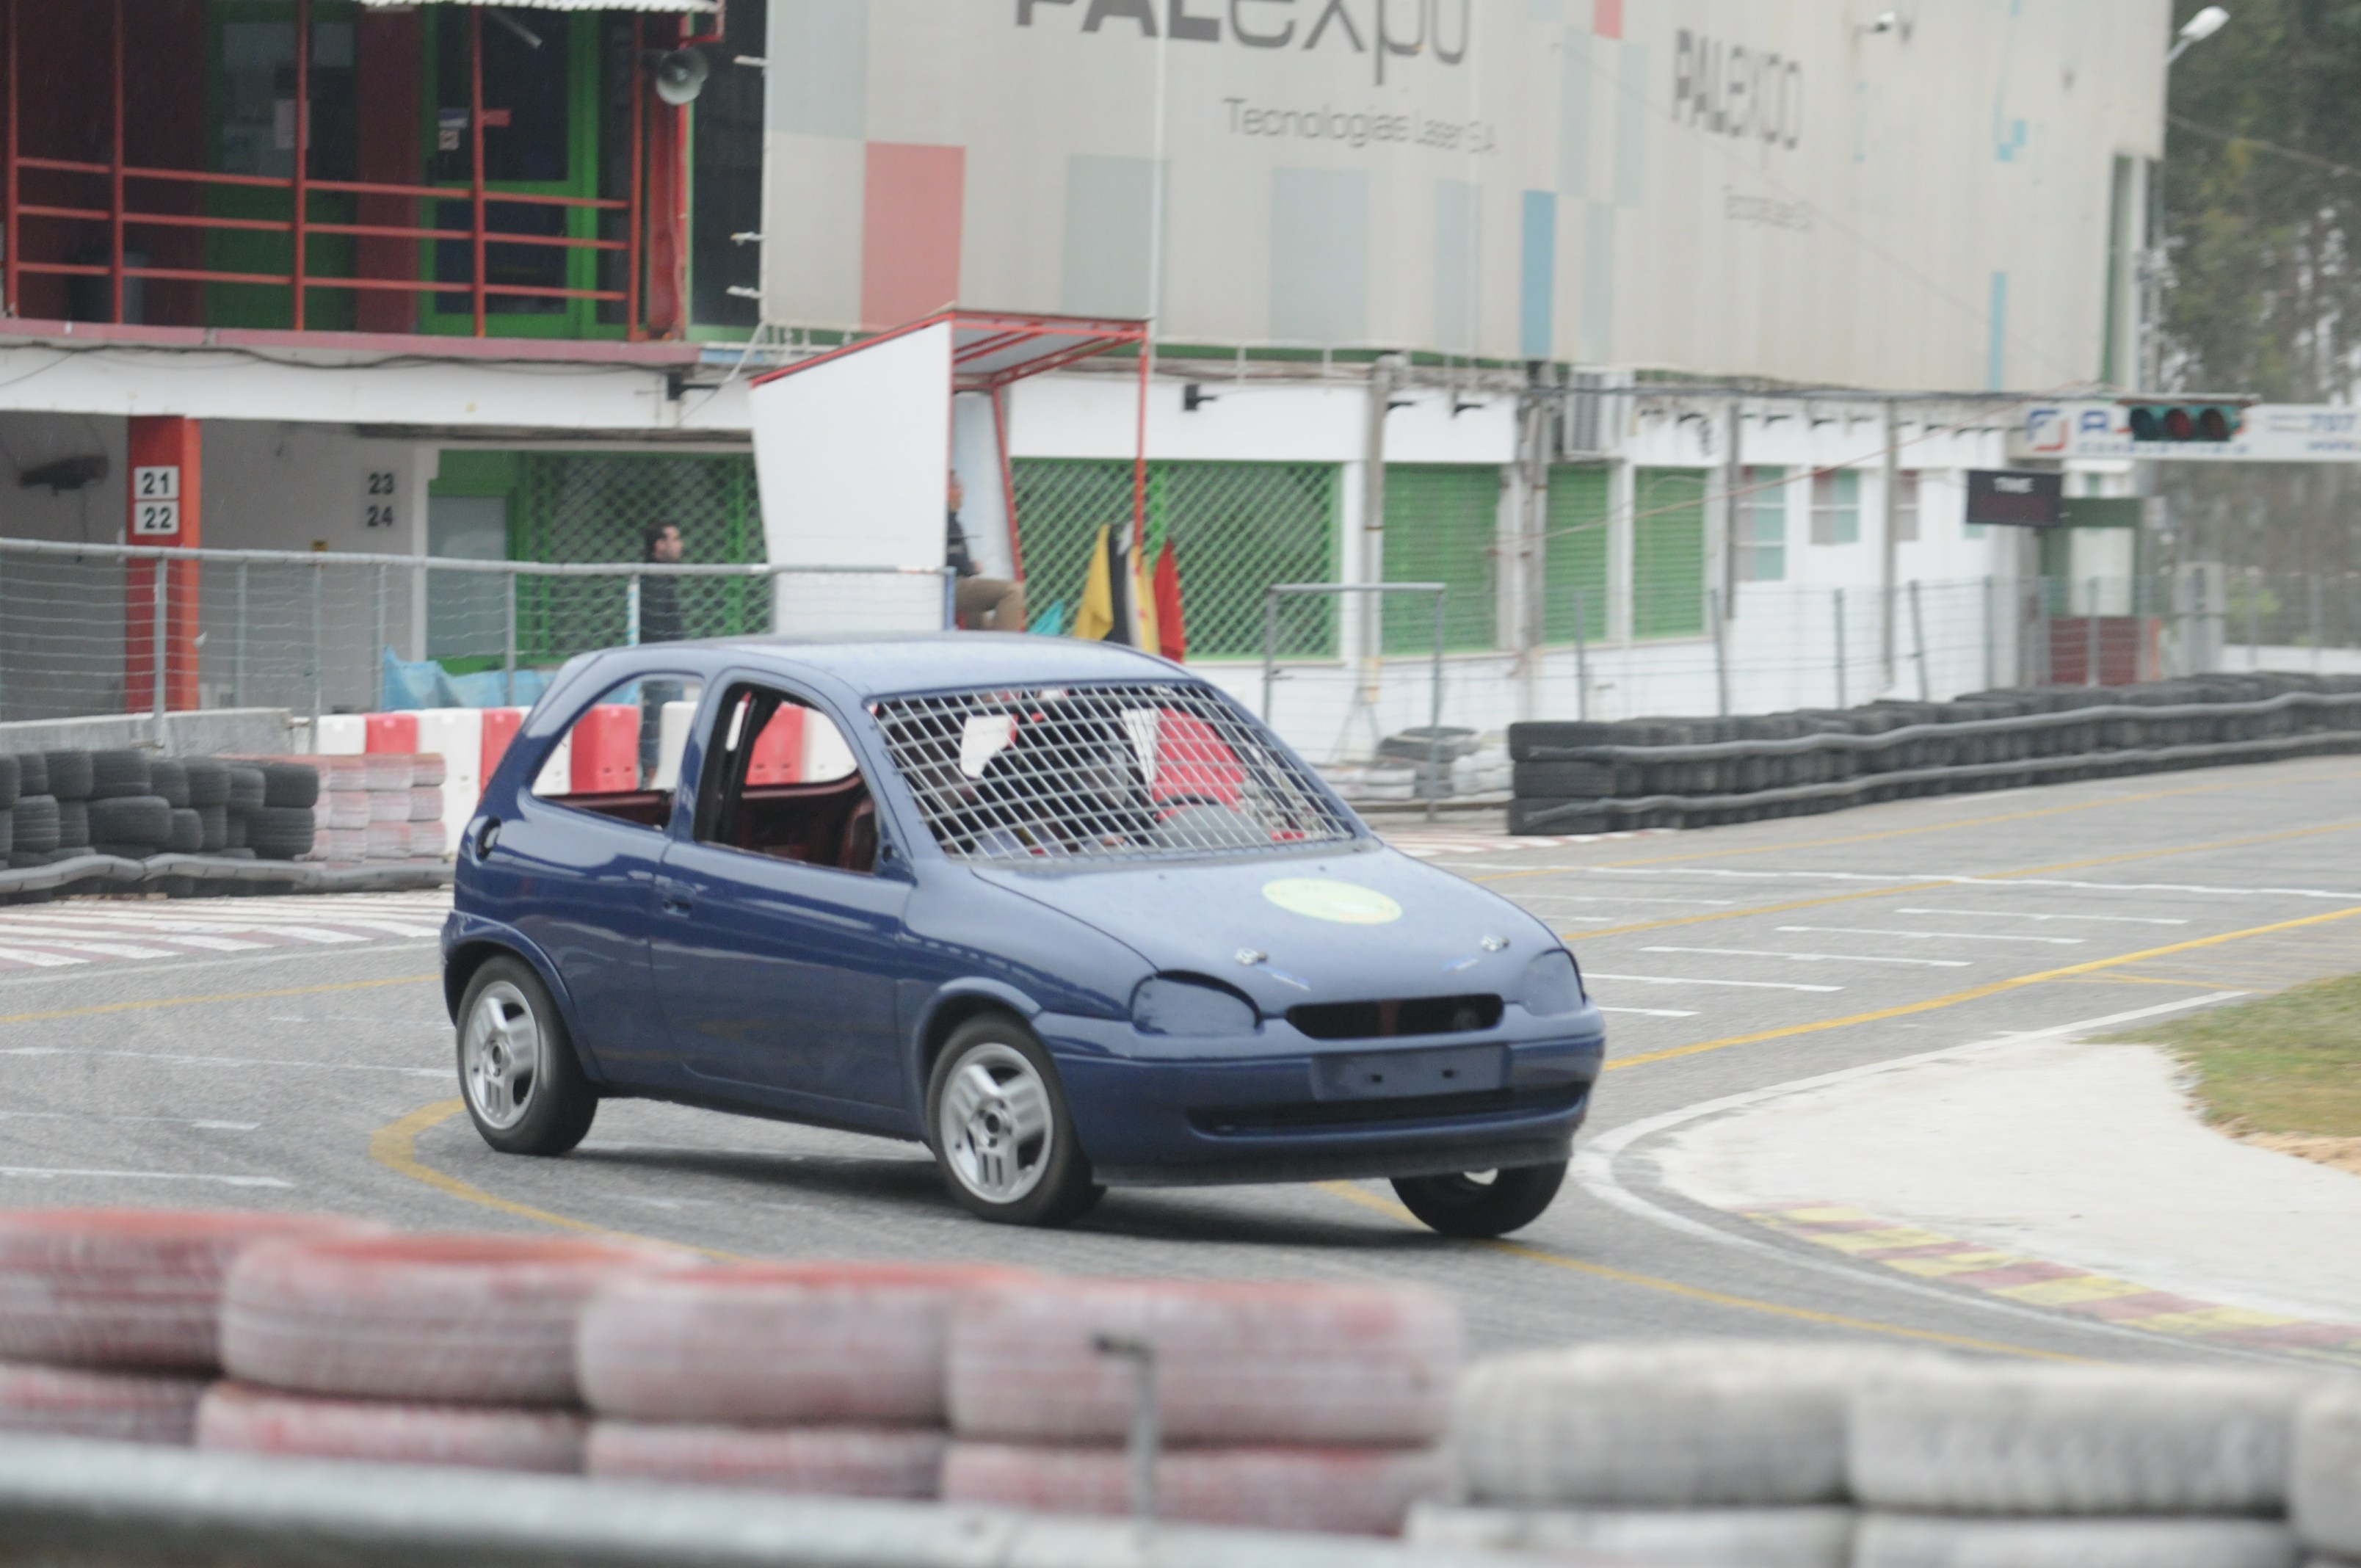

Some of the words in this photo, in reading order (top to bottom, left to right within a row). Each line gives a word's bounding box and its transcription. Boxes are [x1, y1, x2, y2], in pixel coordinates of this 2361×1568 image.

[142, 472, 170, 495] 21
[369, 473, 394, 495] 23
[145, 507, 172, 529] 22
[367, 506, 394, 528] 24
